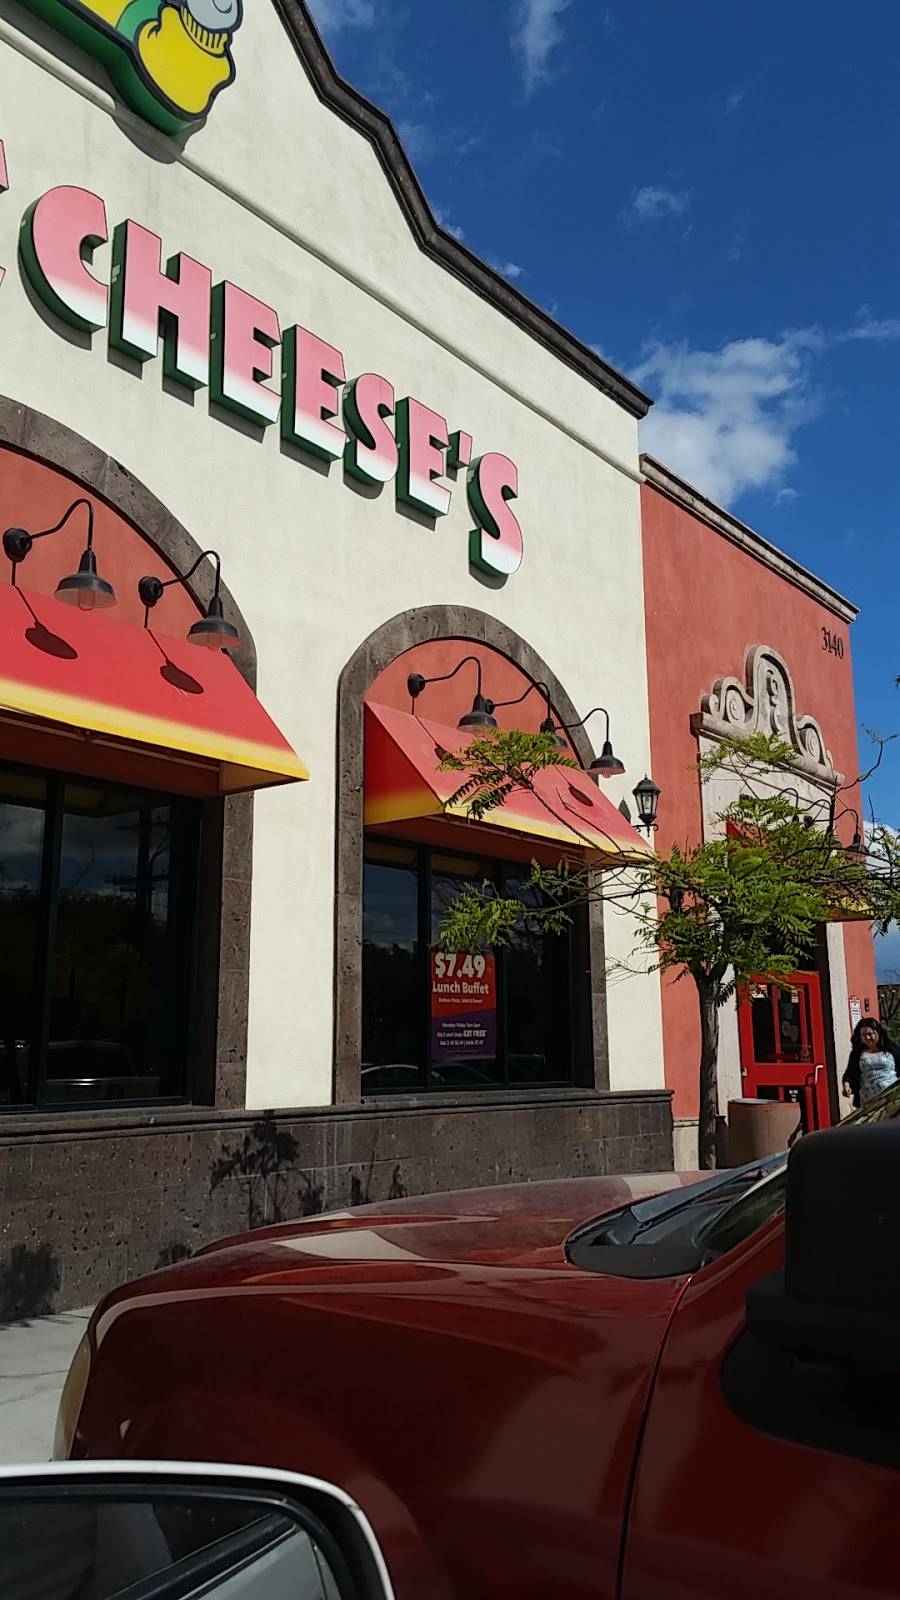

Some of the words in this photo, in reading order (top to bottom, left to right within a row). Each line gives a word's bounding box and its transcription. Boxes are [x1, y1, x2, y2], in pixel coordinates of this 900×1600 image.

[18, 185, 524, 575] CHEESE'S
[821, 627, 844, 660] 3140
[434, 952, 486, 978] $7.49
[432, 981, 461, 994] Lunch
[462, 982, 490, 995] Buffet
